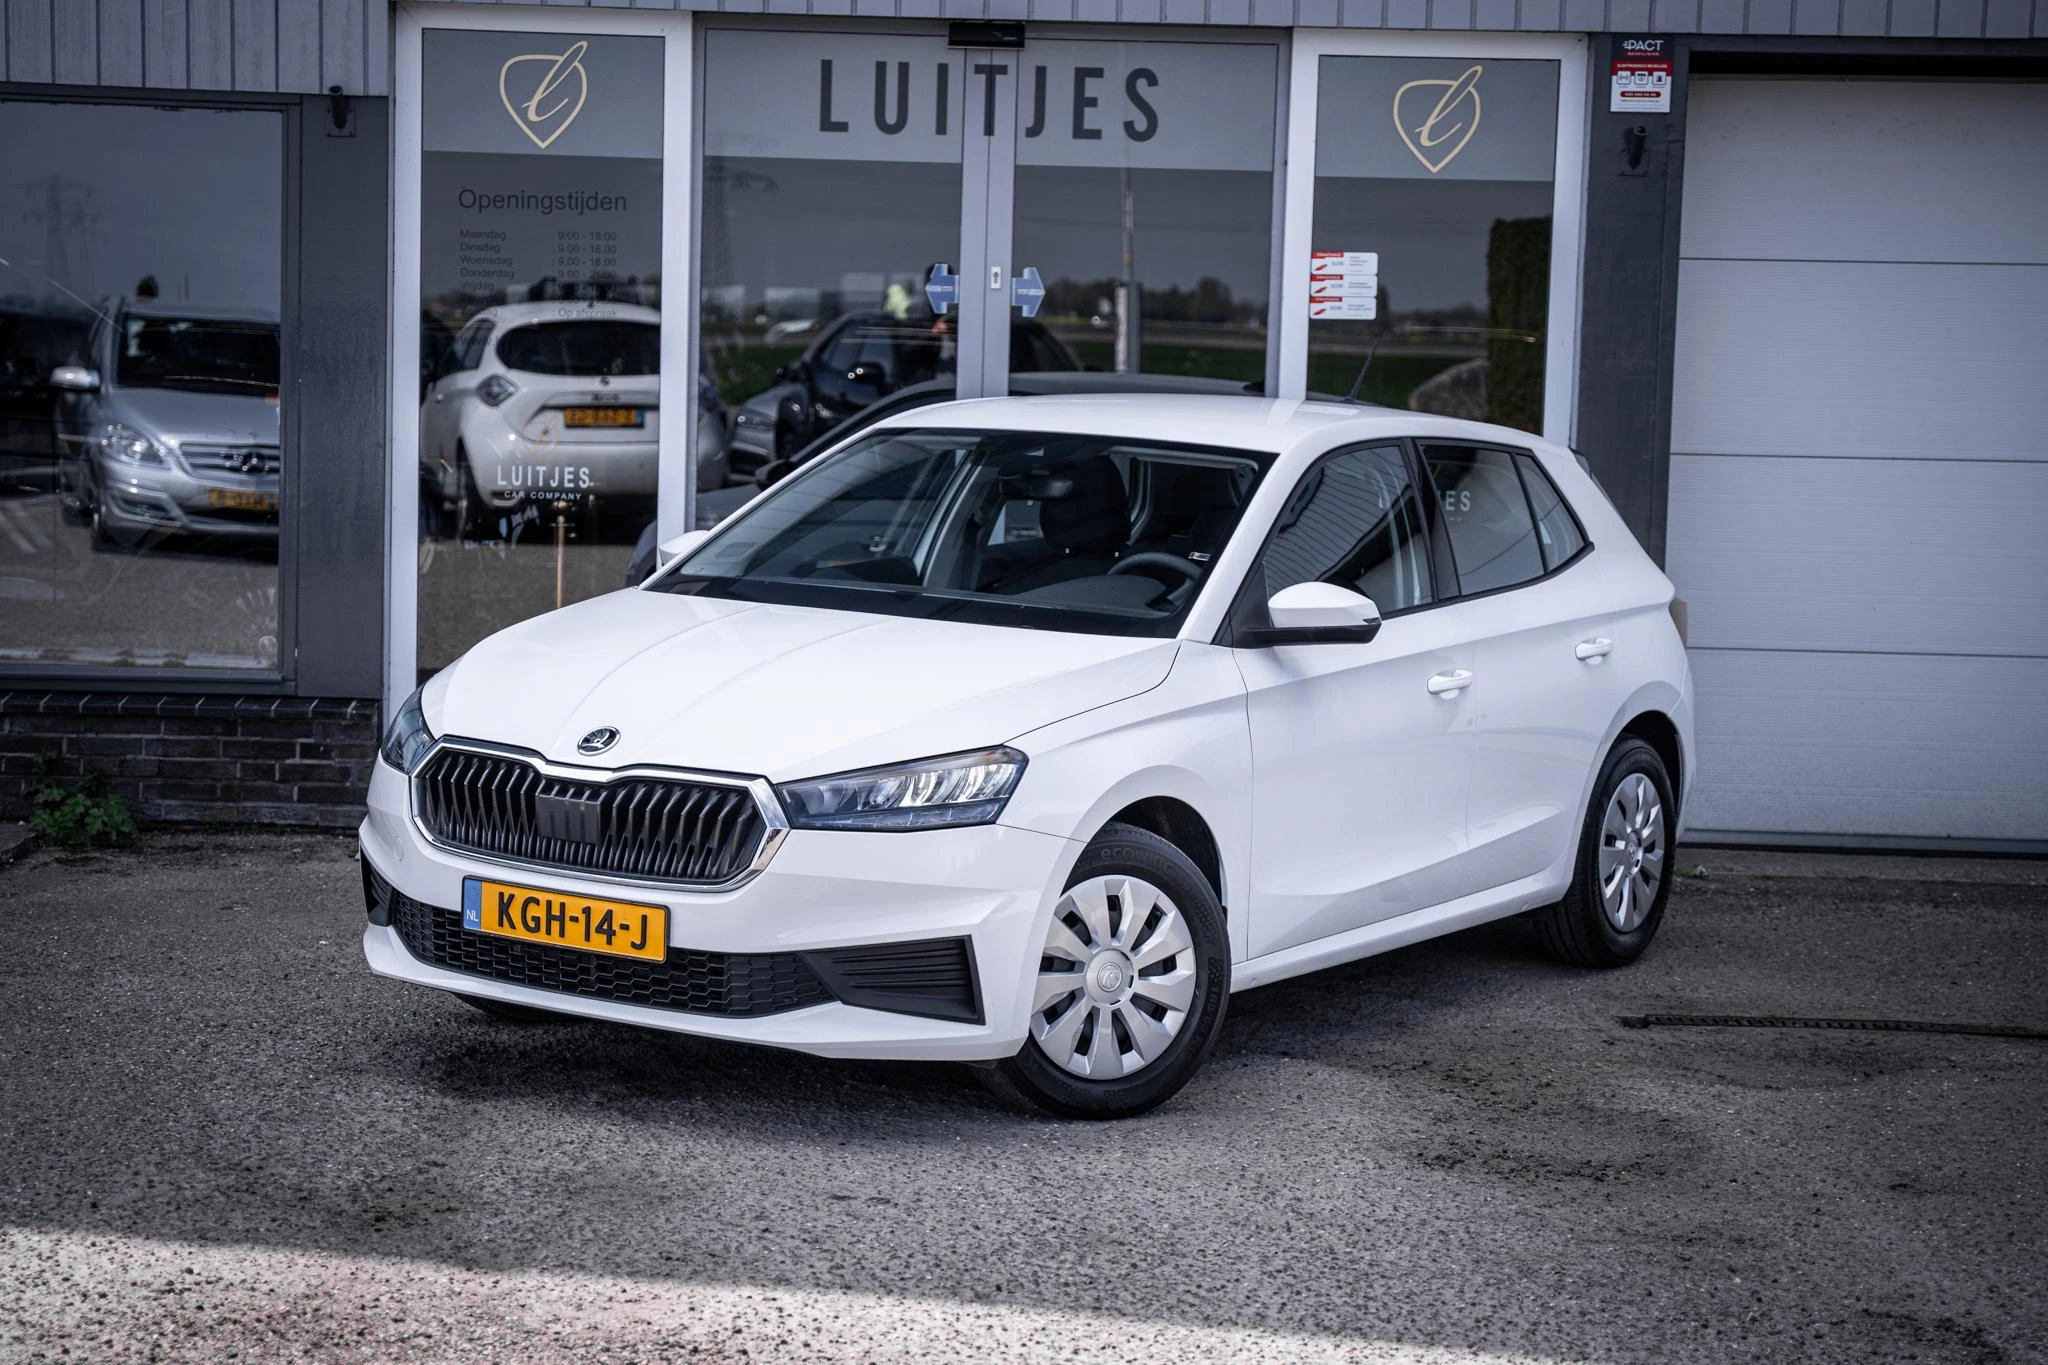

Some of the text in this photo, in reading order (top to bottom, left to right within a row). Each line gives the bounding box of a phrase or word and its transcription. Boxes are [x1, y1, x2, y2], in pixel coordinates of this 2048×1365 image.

[1623, 39, 1664, 51] PACT
[819, 59, 1160, 142] LUITJES
[458, 187, 628, 215] Openingstijden
[460, 229, 506, 241] Maandag
[460, 242, 501, 254] Dinsdag
[460, 255, 513, 267] Woensdag
[460, 268, 515, 280] Donderdag
[460, 281, 495, 292] Vrijdag
[497, 465, 591, 489] LUITJES
[504, 491, 582, 501] CAR COMPANY
[467, 891, 648, 951] NL KGH-14-J
